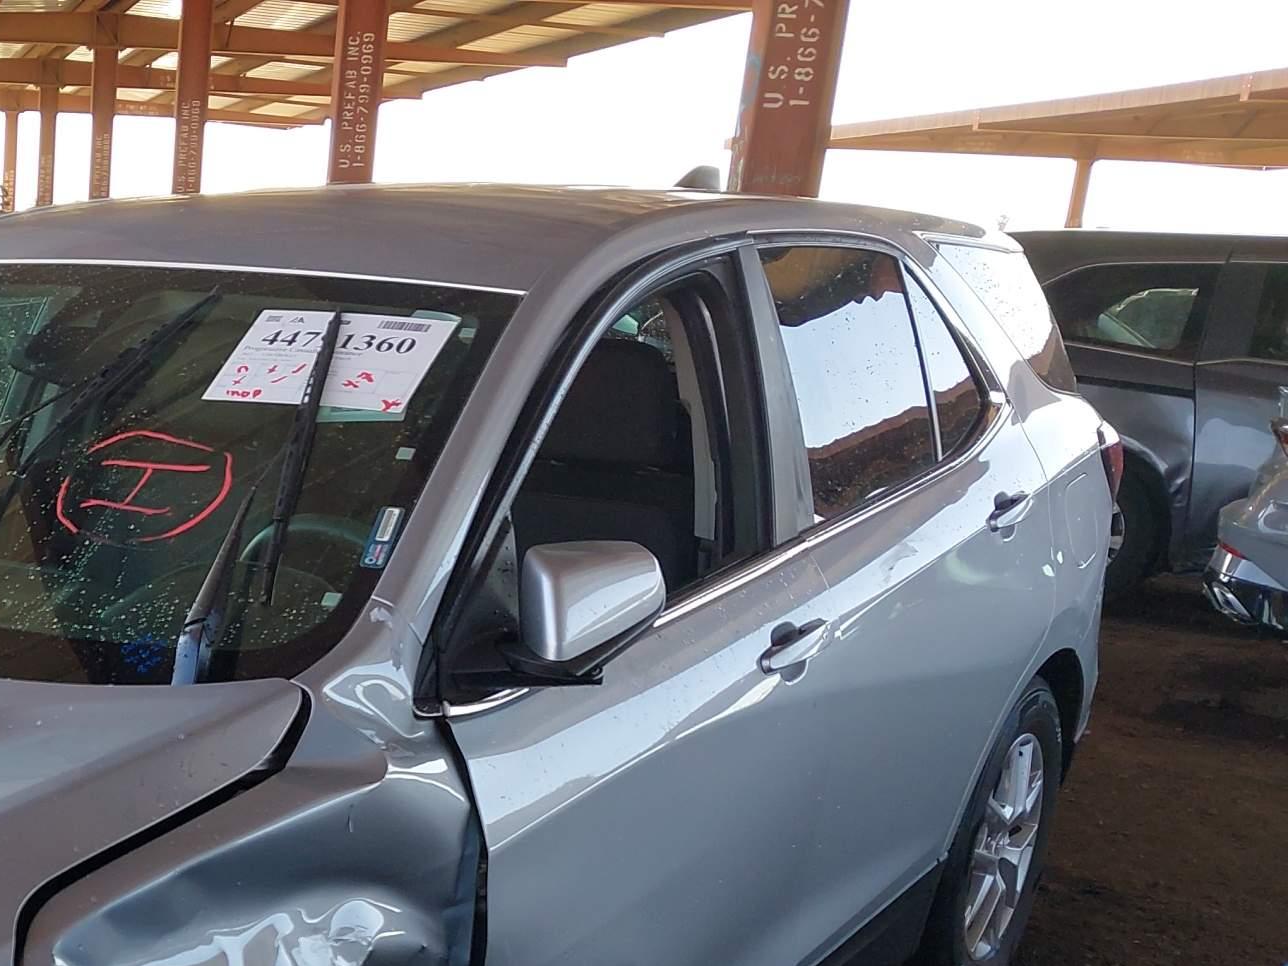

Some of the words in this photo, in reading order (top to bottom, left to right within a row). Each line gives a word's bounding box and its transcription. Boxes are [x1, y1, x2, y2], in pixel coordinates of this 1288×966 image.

[346, 31, 361, 61] INC.
[342, 69, 359, 130] PREFAB
[352, 32, 375, 167] 1-866-799-0969
[338, 139, 353, 168] U.S.
[262, 329, 417, 355] 4471360
